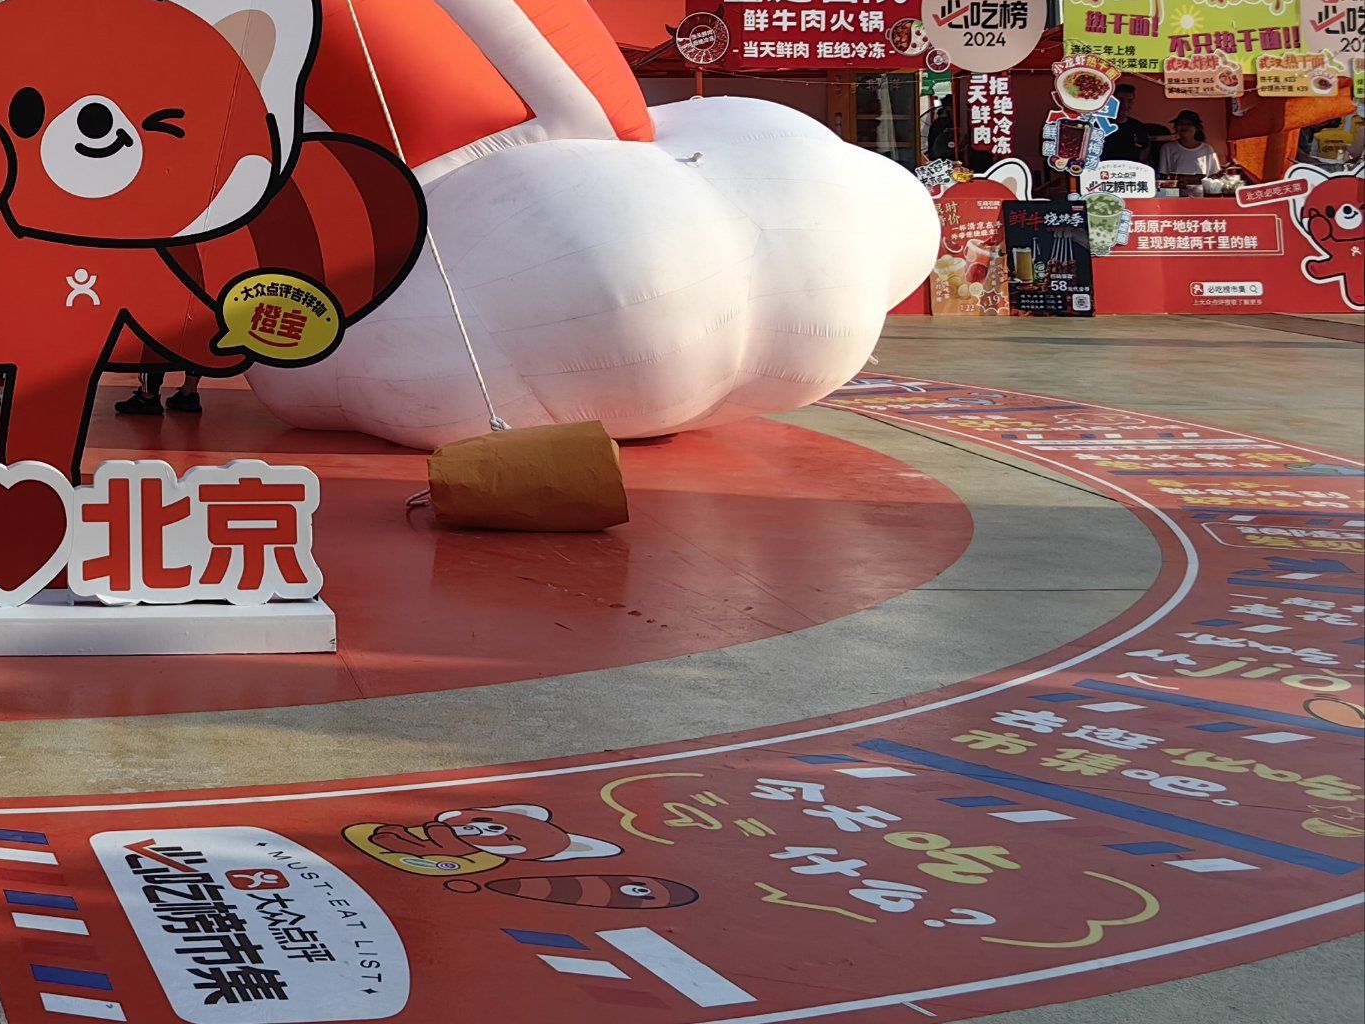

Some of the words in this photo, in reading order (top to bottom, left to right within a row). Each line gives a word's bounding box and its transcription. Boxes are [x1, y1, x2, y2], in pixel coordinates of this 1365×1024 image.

[743, 8, 885, 33] 鲜牛肉火锅
[933, 0, 1028, 29] 必吃榜
[743, 41, 810, 59] 当天鲜肉
[816, 42, 886, 59] 拒绝冷冻
[963, 31, 1007, 47] 2024
[1340, 37, 1365, 53] 20
[989, 75, 1014, 155] 拒绝冷冻
[1137, 236, 1259, 250] 呈现跨越两千里的鲜
[240, 282, 328, 318] 大众点评吉祥物
[250, 303, 308, 341] 橙宝
[81, 477, 309, 592] 北京
[123, 838, 290, 1005] 必吃榜市集
[246, 892, 337, 964] 大众点评
[268, 850, 367, 930] MUST-EAT
[354, 939, 383, 983] LIST
